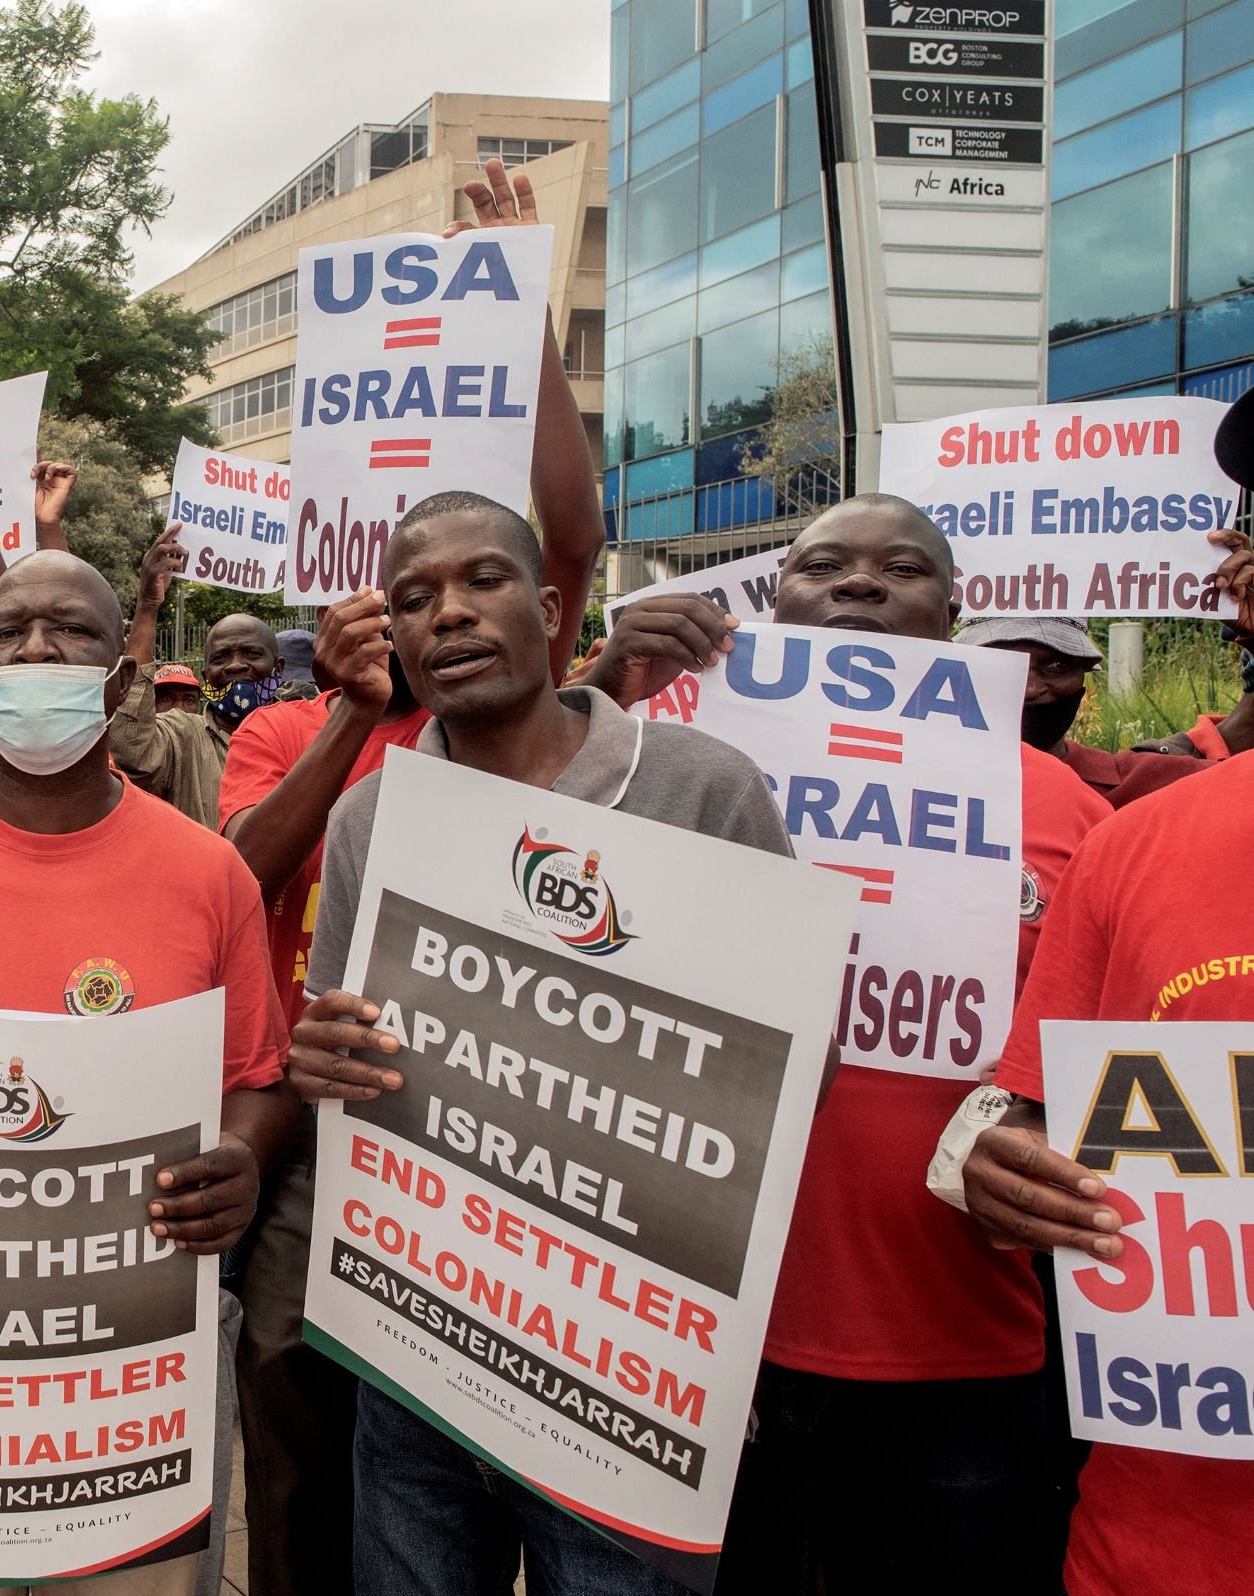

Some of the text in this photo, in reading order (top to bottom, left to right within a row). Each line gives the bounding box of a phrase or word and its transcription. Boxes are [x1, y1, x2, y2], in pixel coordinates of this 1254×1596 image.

[909, 42, 958, 65] BCG
[962, 52, 1002, 60] CONSULTING
[902, 87, 1013, 106] COX YEATS
[917, 136, 945, 147] TCM
[955, 129, 1006, 140] TECHNOLOGY
[955, 140, 999, 149] CORPORATE
[955, 148, 1008, 159] MANAGEMENT
[949, 178, 1005, 196] Africa
[313, 241, 521, 315] USA
[301, 365, 527, 427] ISRAEL
[937, 415, 1180, 468] Shut down
[204, 457, 290, 501] Shut do
[172, 491, 245, 536] Israeli
[1031, 486, 1233, 536] Embassy
[195, 546, 266, 590] South
[724, 632, 990, 732] USA
[546, 864, 578, 879] AFRICAN
[553, 859, 577, 871] SOUTH
[535, 872, 598, 919] BDS
[537, 907, 586, 930] COALITION
[410, 926, 723, 1078] BOYCOTT
[373, 999, 735, 1179] APARTHEID
[426, 1095, 639, 1236] ISRAEL
[350, 1134, 718, 1355] END SETTLER
[343, 1199, 706, 1428] COLONIALISM
[339, 1252, 691, 1476] #SAVESHEIKHJARRAH
[376, 1319, 623, 1476] FREEDOM JUSTICE EQUALITY
[56, 1511, 132, 1533] EQUALITY
